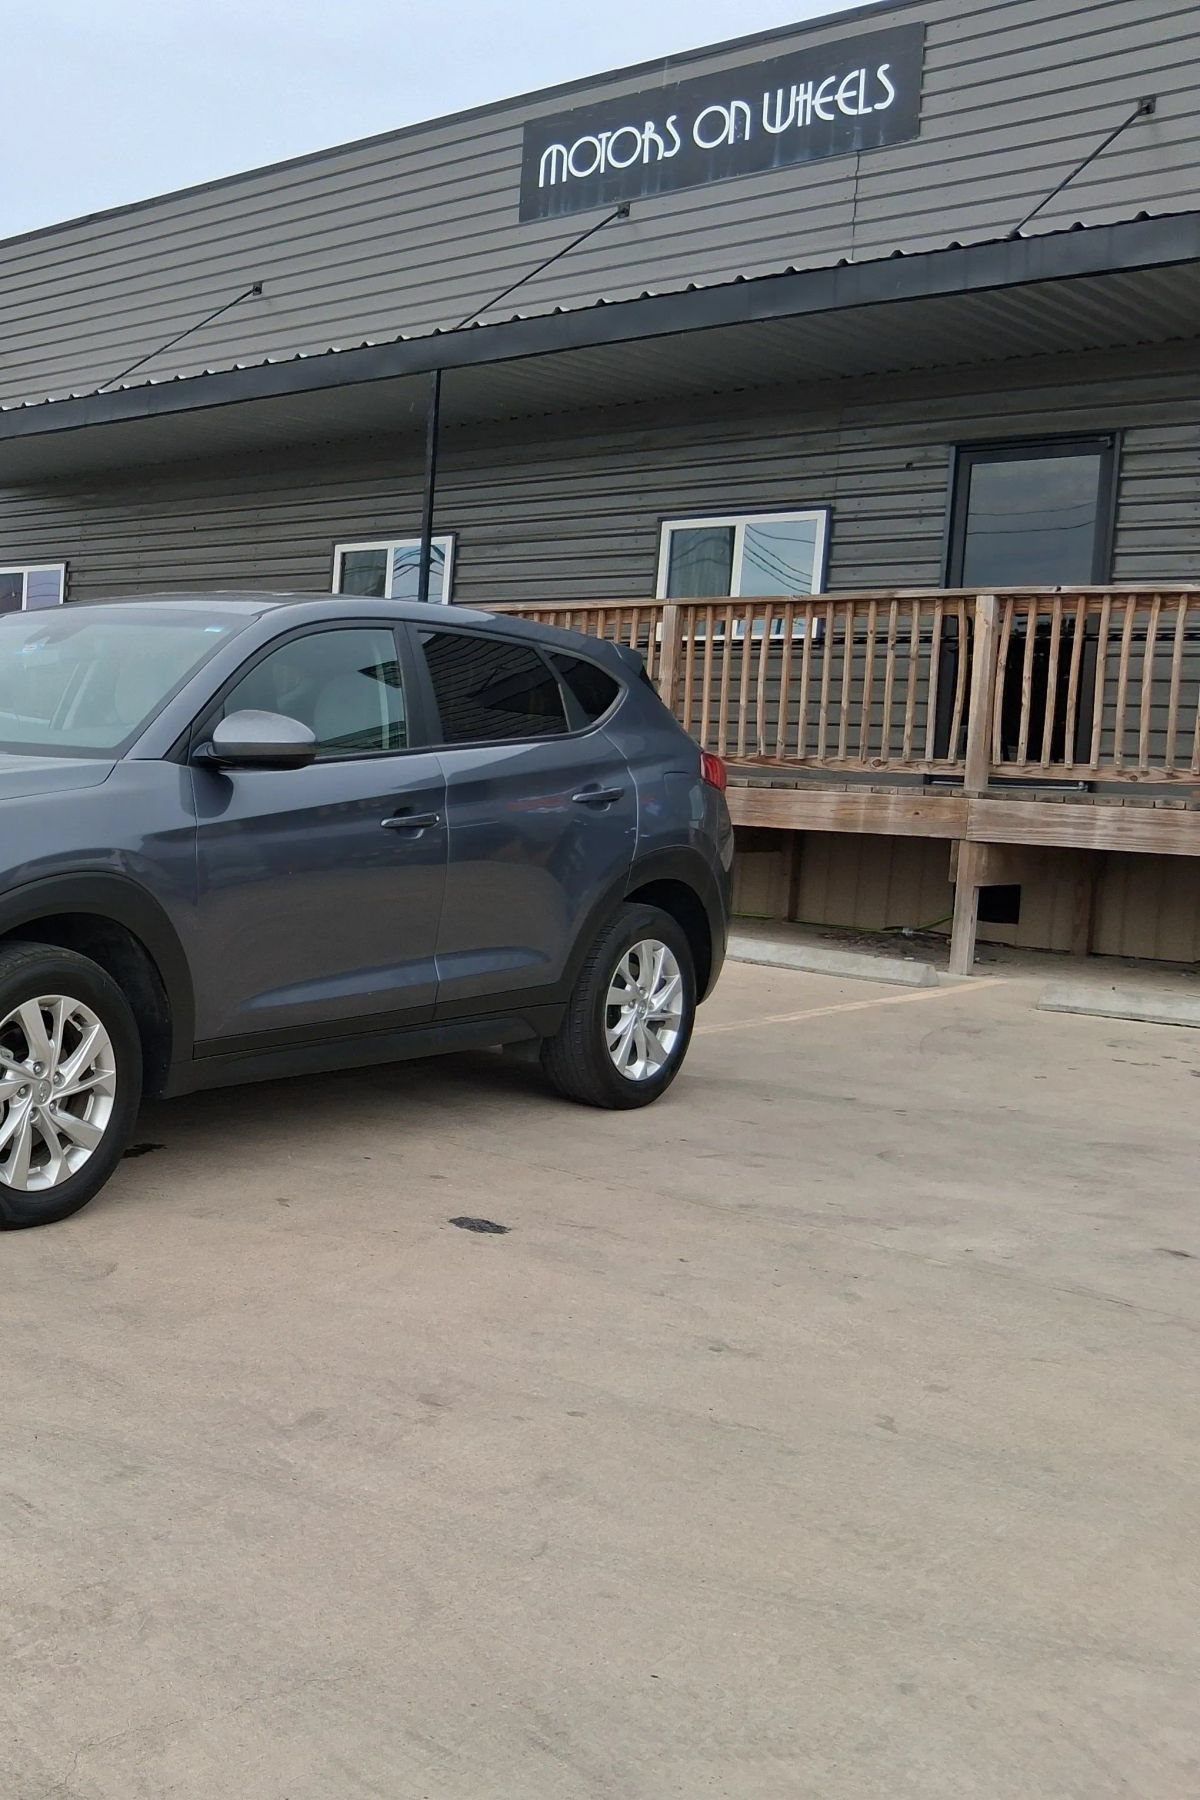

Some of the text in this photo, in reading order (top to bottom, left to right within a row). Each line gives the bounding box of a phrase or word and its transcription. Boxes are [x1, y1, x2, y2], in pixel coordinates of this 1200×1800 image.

[538, 63, 895, 187] MOTORS ON WHEELS
